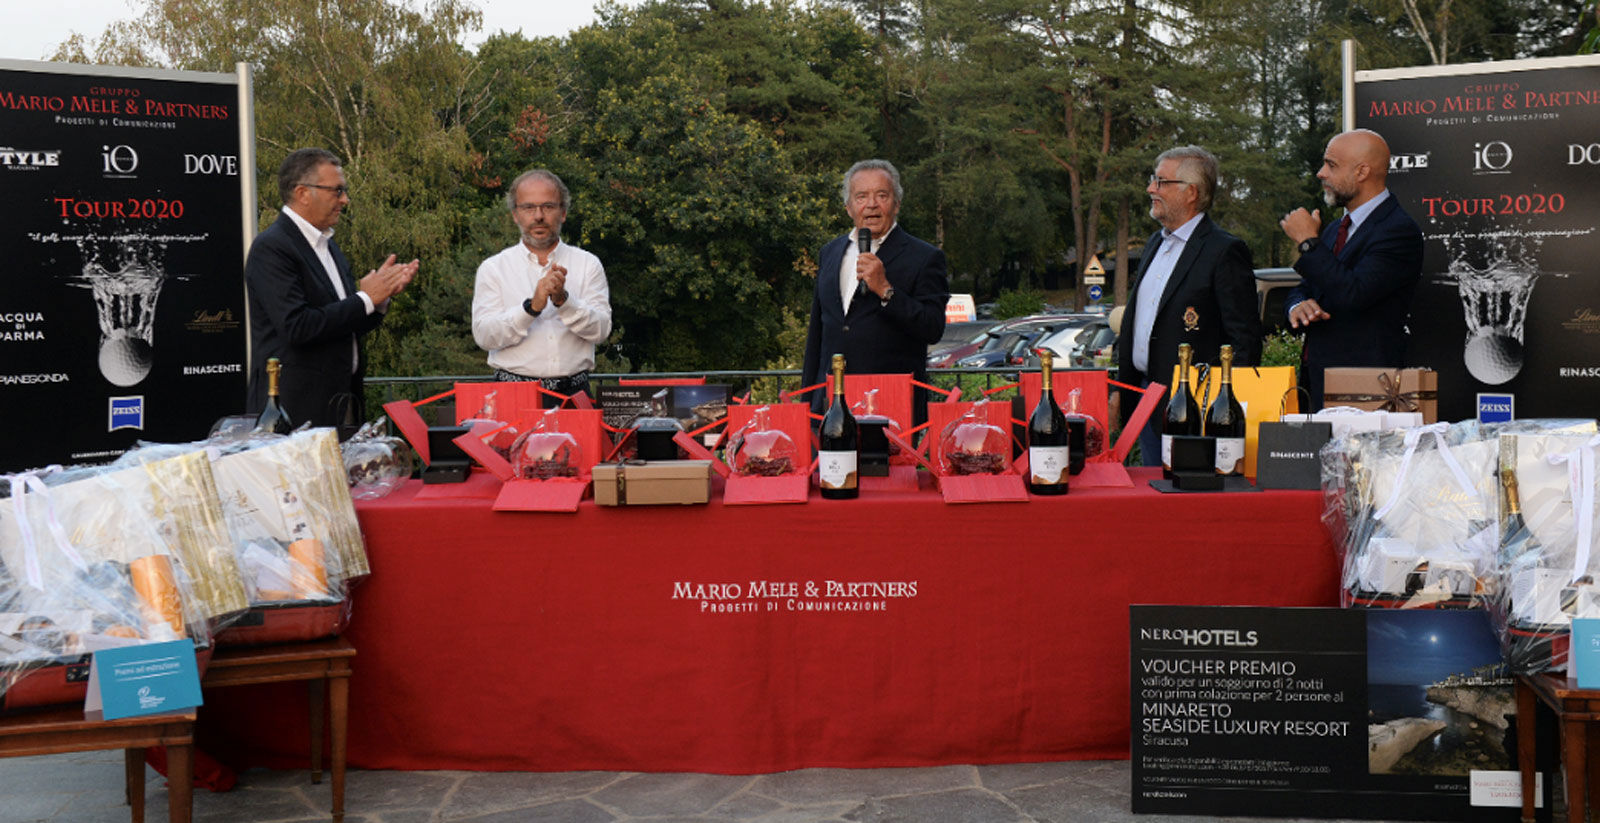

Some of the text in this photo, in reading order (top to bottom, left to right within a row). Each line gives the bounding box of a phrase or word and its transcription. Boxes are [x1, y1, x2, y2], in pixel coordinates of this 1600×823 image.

[90, 86, 140, 97] GRUPPO
[1464, 82, 1520, 94] GRUPPO
[0, 92, 228, 120] MARIO MELE & PARTNERS
[1369, 100, 1436, 118] MARIO
[1442, 96, 1496, 113] MELE
[1502, 92, 1516, 110] &
[56, 116, 94, 126] PROGETTI
[113, 118, 176, 129] COMUNICAZIONE
[1426, 117, 1466, 126] PROGETTI
[1486, 113, 1560, 122] COMUNICAZIONE
[1568, 144, 1600, 166] DO
[184, 154, 238, 176] DOVE
[0, 312, 44, 323] ACQUA
[184, 364, 242, 376] RINASCENTE
[112, 406, 140, 416] ZEISS
[1480, 404, 1510, 412] ZEISS
[672, 580, 918, 600] MARIO MELE & PARTNERS
[701, 599, 886, 612] PROGETTI DI COMUNICAZIONE
[1141, 659, 1296, 676] VOUCHER PREMIO
[1142, 676, 1324, 690] valido per un soggiorno di 2 notti
[1142, 689, 1344, 703] con prima colazione per 2 persone al
[1142, 702, 1232, 718] MINARETO
[1142, 718, 1350, 736] SEASIDE LUXURY RESORT
[1142, 736, 1188, 746] Siracusa
